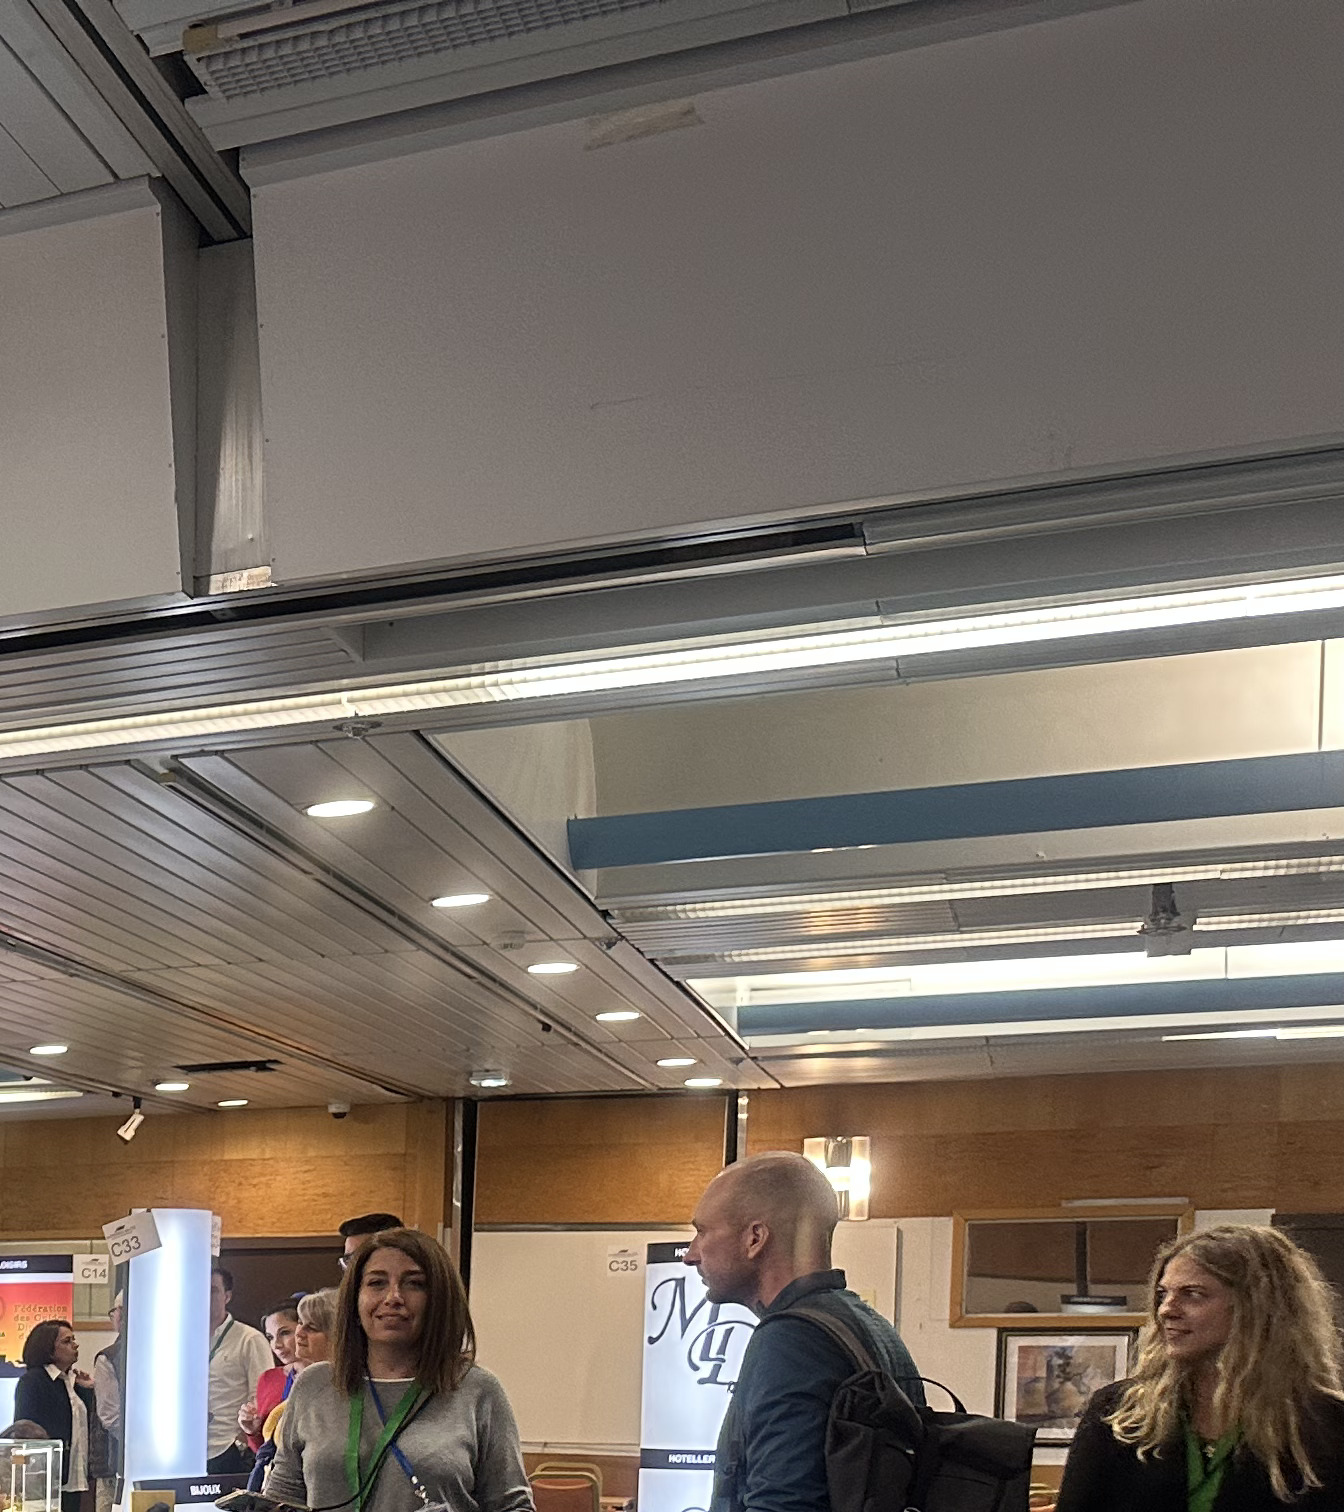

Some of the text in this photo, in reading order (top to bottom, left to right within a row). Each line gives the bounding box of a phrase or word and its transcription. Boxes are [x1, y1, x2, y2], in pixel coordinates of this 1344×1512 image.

[111, 1236, 141, 1257] C33
[608, 1260, 638, 1272] C35
[81, 1268, 107, 1279] C14
[190, 1484, 221, 1496] BIJOUX
